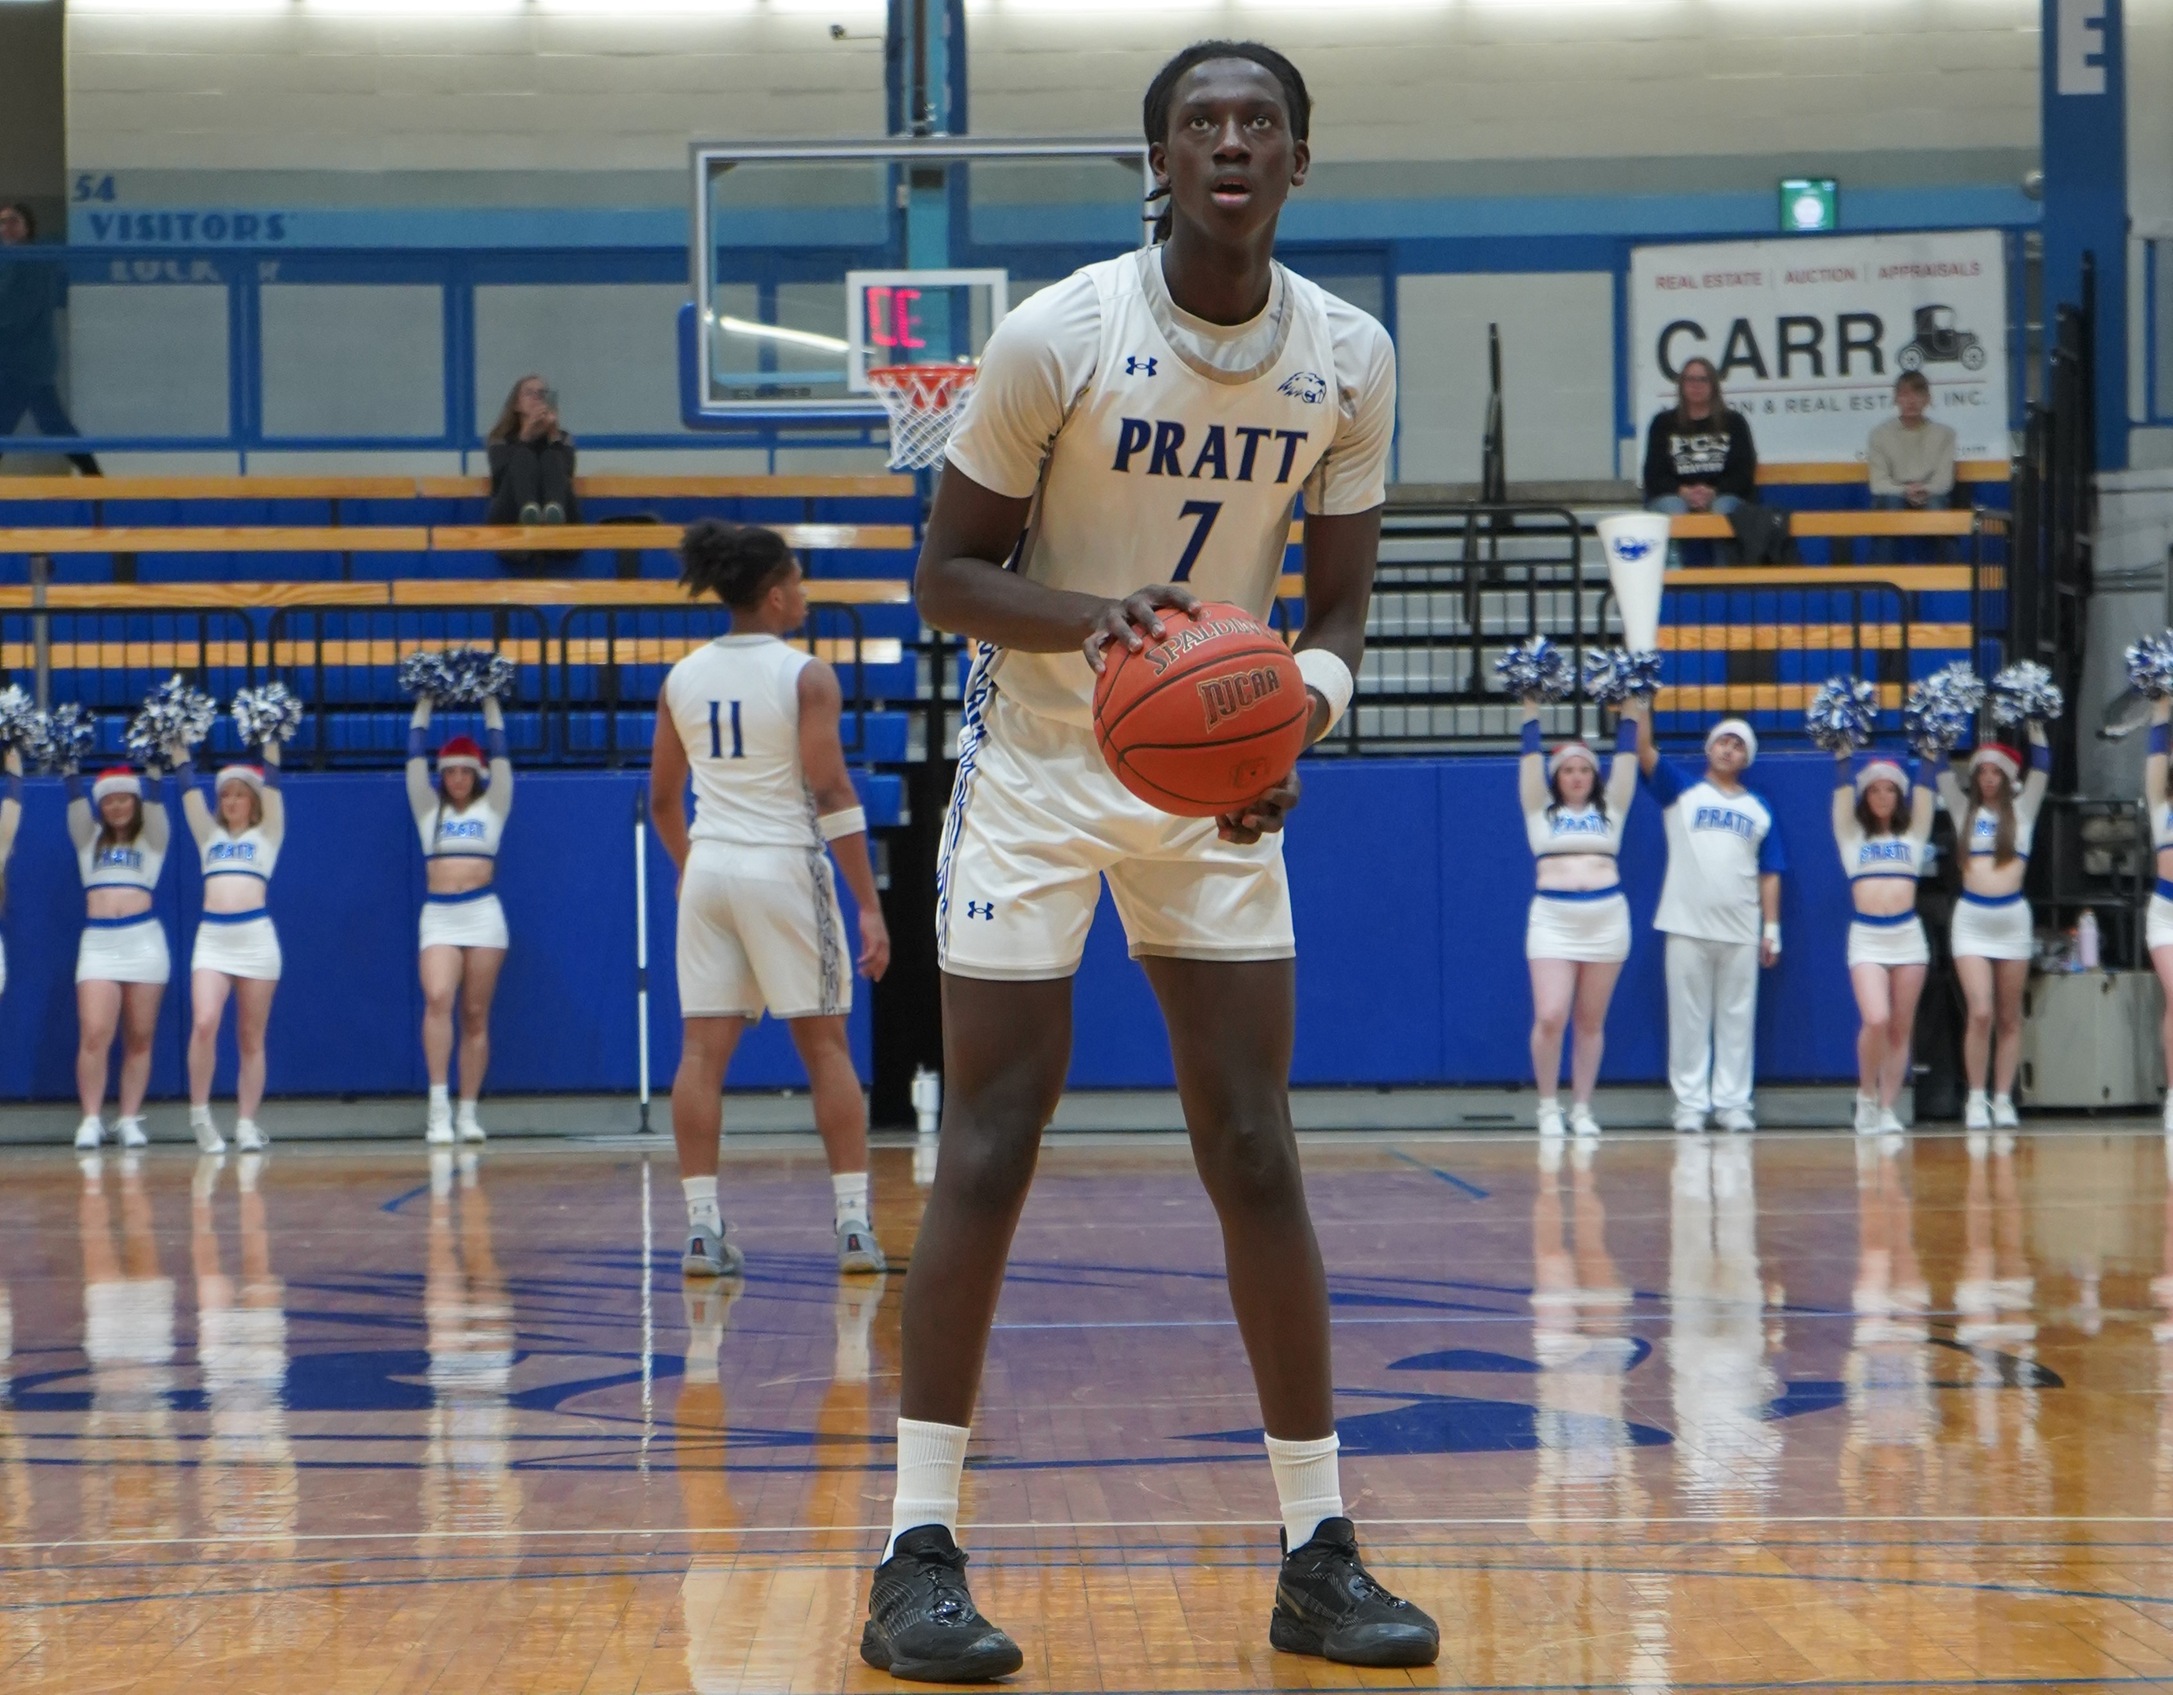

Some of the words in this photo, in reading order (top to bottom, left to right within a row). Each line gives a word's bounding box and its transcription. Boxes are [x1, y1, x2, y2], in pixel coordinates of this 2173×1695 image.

[88, 212, 287, 242] VISITORS
[1655, 274, 1698, 291] REAL
[1702, 271, 1763, 288] ESTATE
[1784, 267, 1857, 285] AUCTION
[1877, 261, 1982, 280] APPRAISALS
[1656, 312, 1886, 382] CARR
[1785, 397, 1842, 413] REAL
[1110, 417, 1309, 484] PRATT
[1170, 499, 1225, 583] 7
[1144, 616, 1283, 677] SPALDIN
[708, 699, 746, 759] 11
[1694, 806, 1755, 841] PRATT
